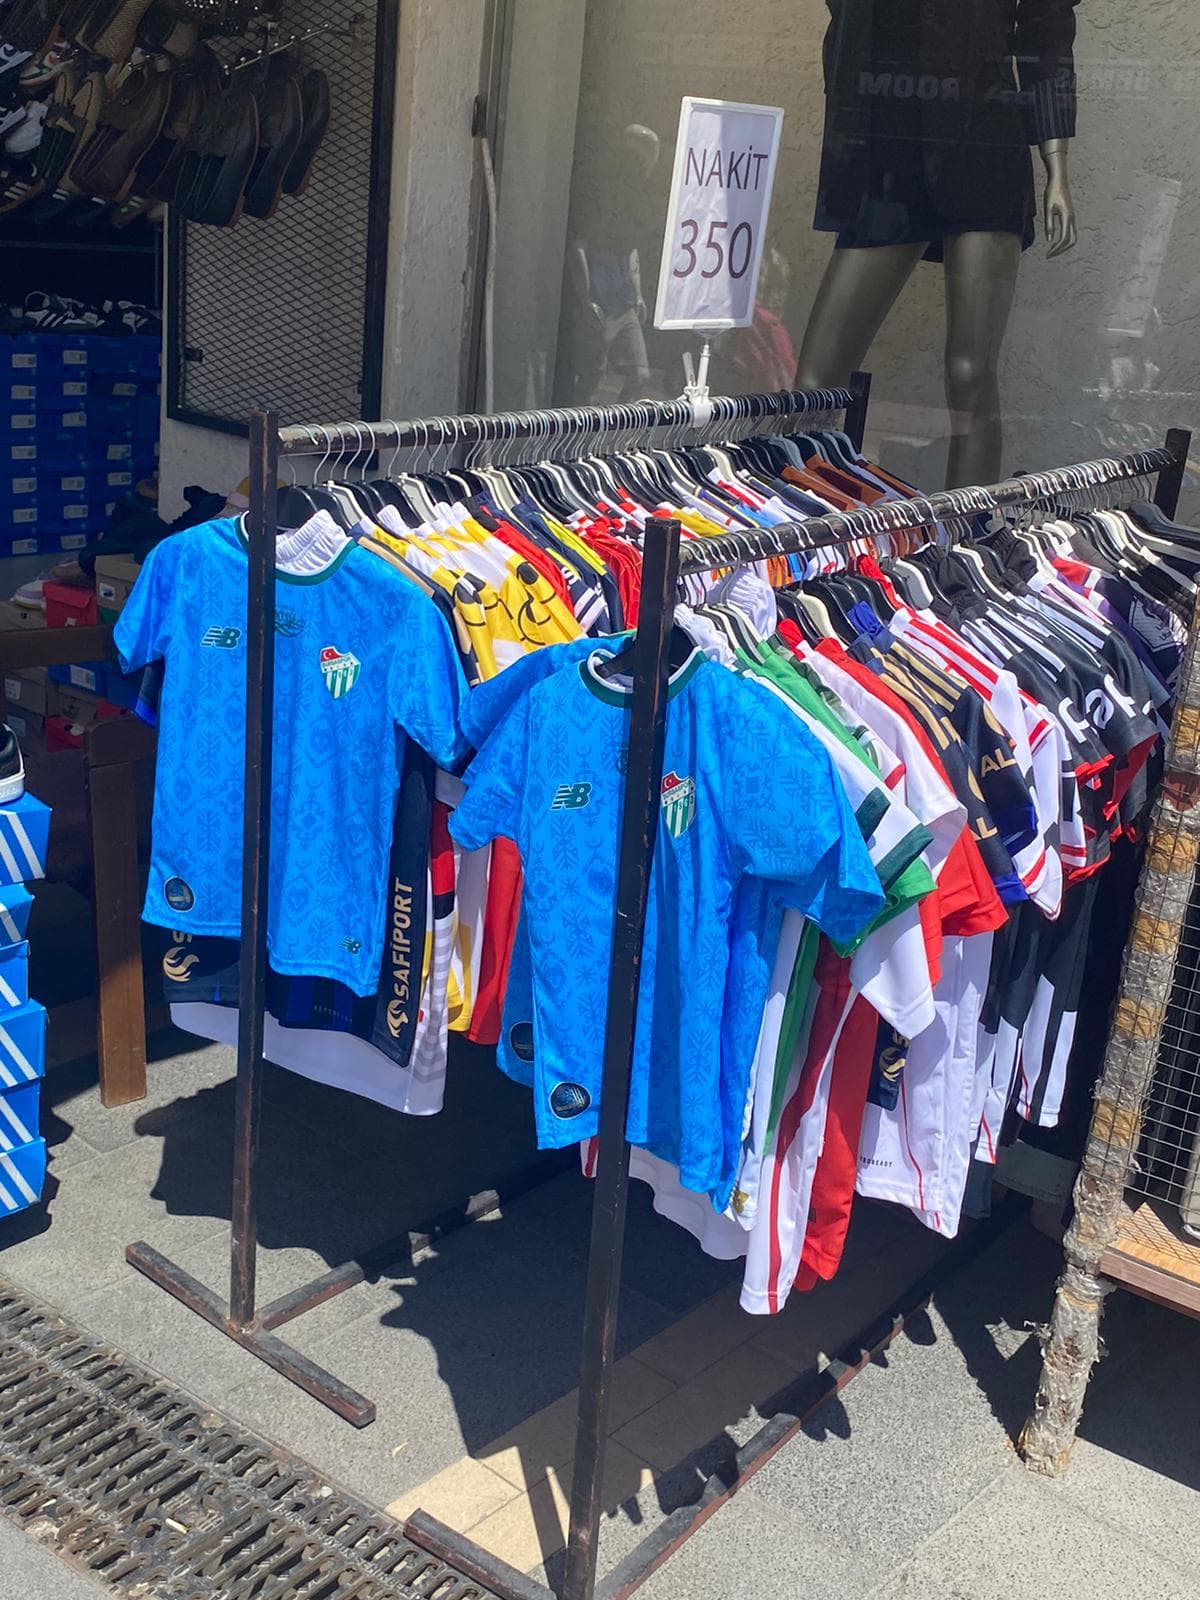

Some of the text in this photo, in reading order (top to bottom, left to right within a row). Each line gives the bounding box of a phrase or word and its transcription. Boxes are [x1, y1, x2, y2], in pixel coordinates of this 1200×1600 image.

[684, 145, 769, 191] NAKİT
[673, 218, 753, 279] 350
[391, 877, 413, 1000] SAFİPORT
